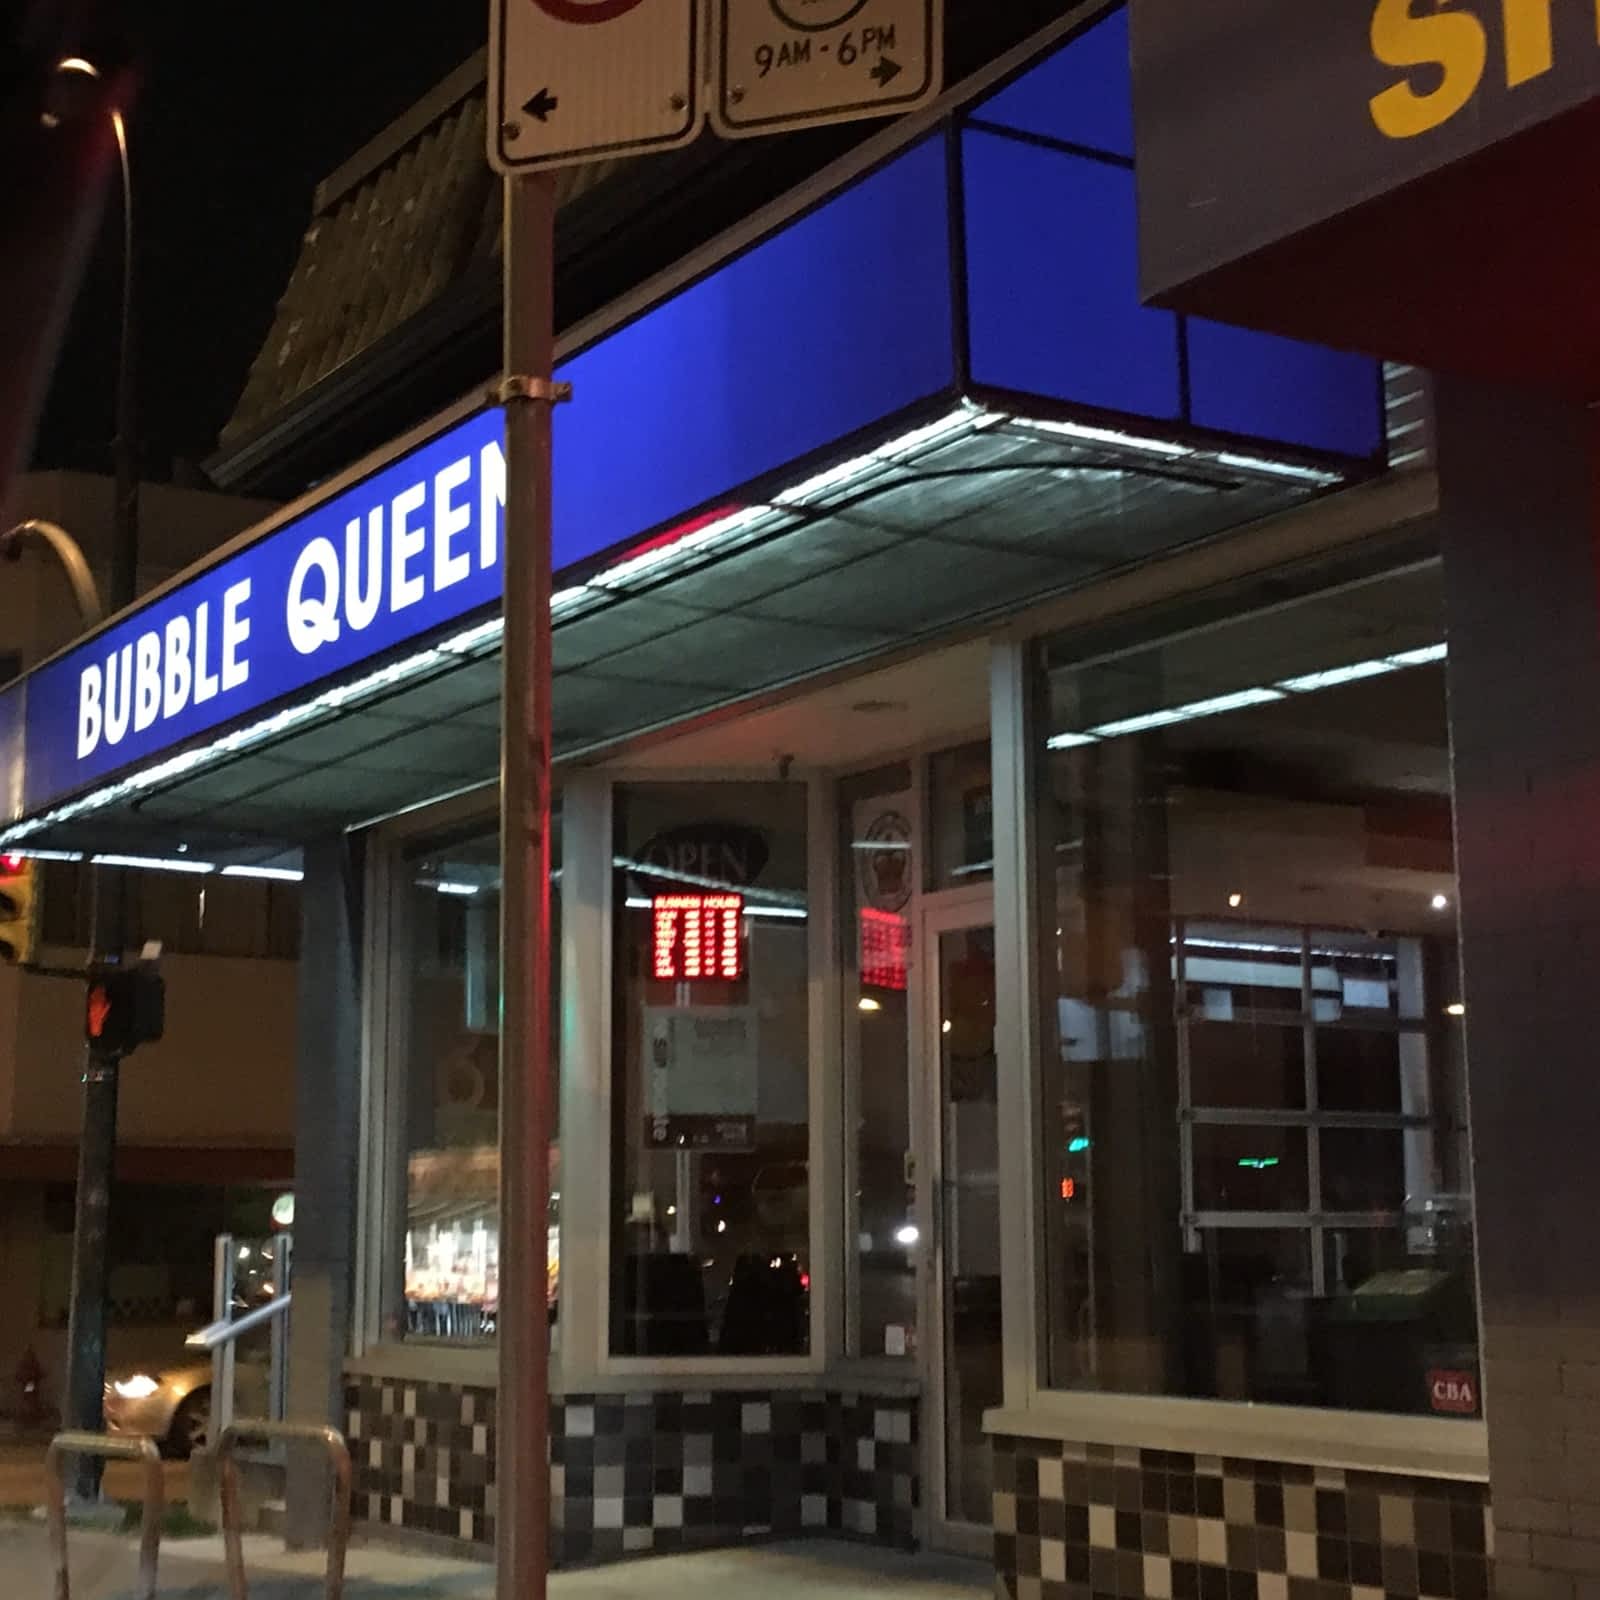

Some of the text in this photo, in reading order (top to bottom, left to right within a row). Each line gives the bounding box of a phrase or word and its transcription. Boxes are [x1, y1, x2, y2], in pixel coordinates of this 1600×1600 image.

[754, 38, 811, 79] 9AM
[837, 23, 896, 66] 6PM
[77, 577, 251, 760] BUBBLE
[1433, 1380, 1472, 1401] CBA
